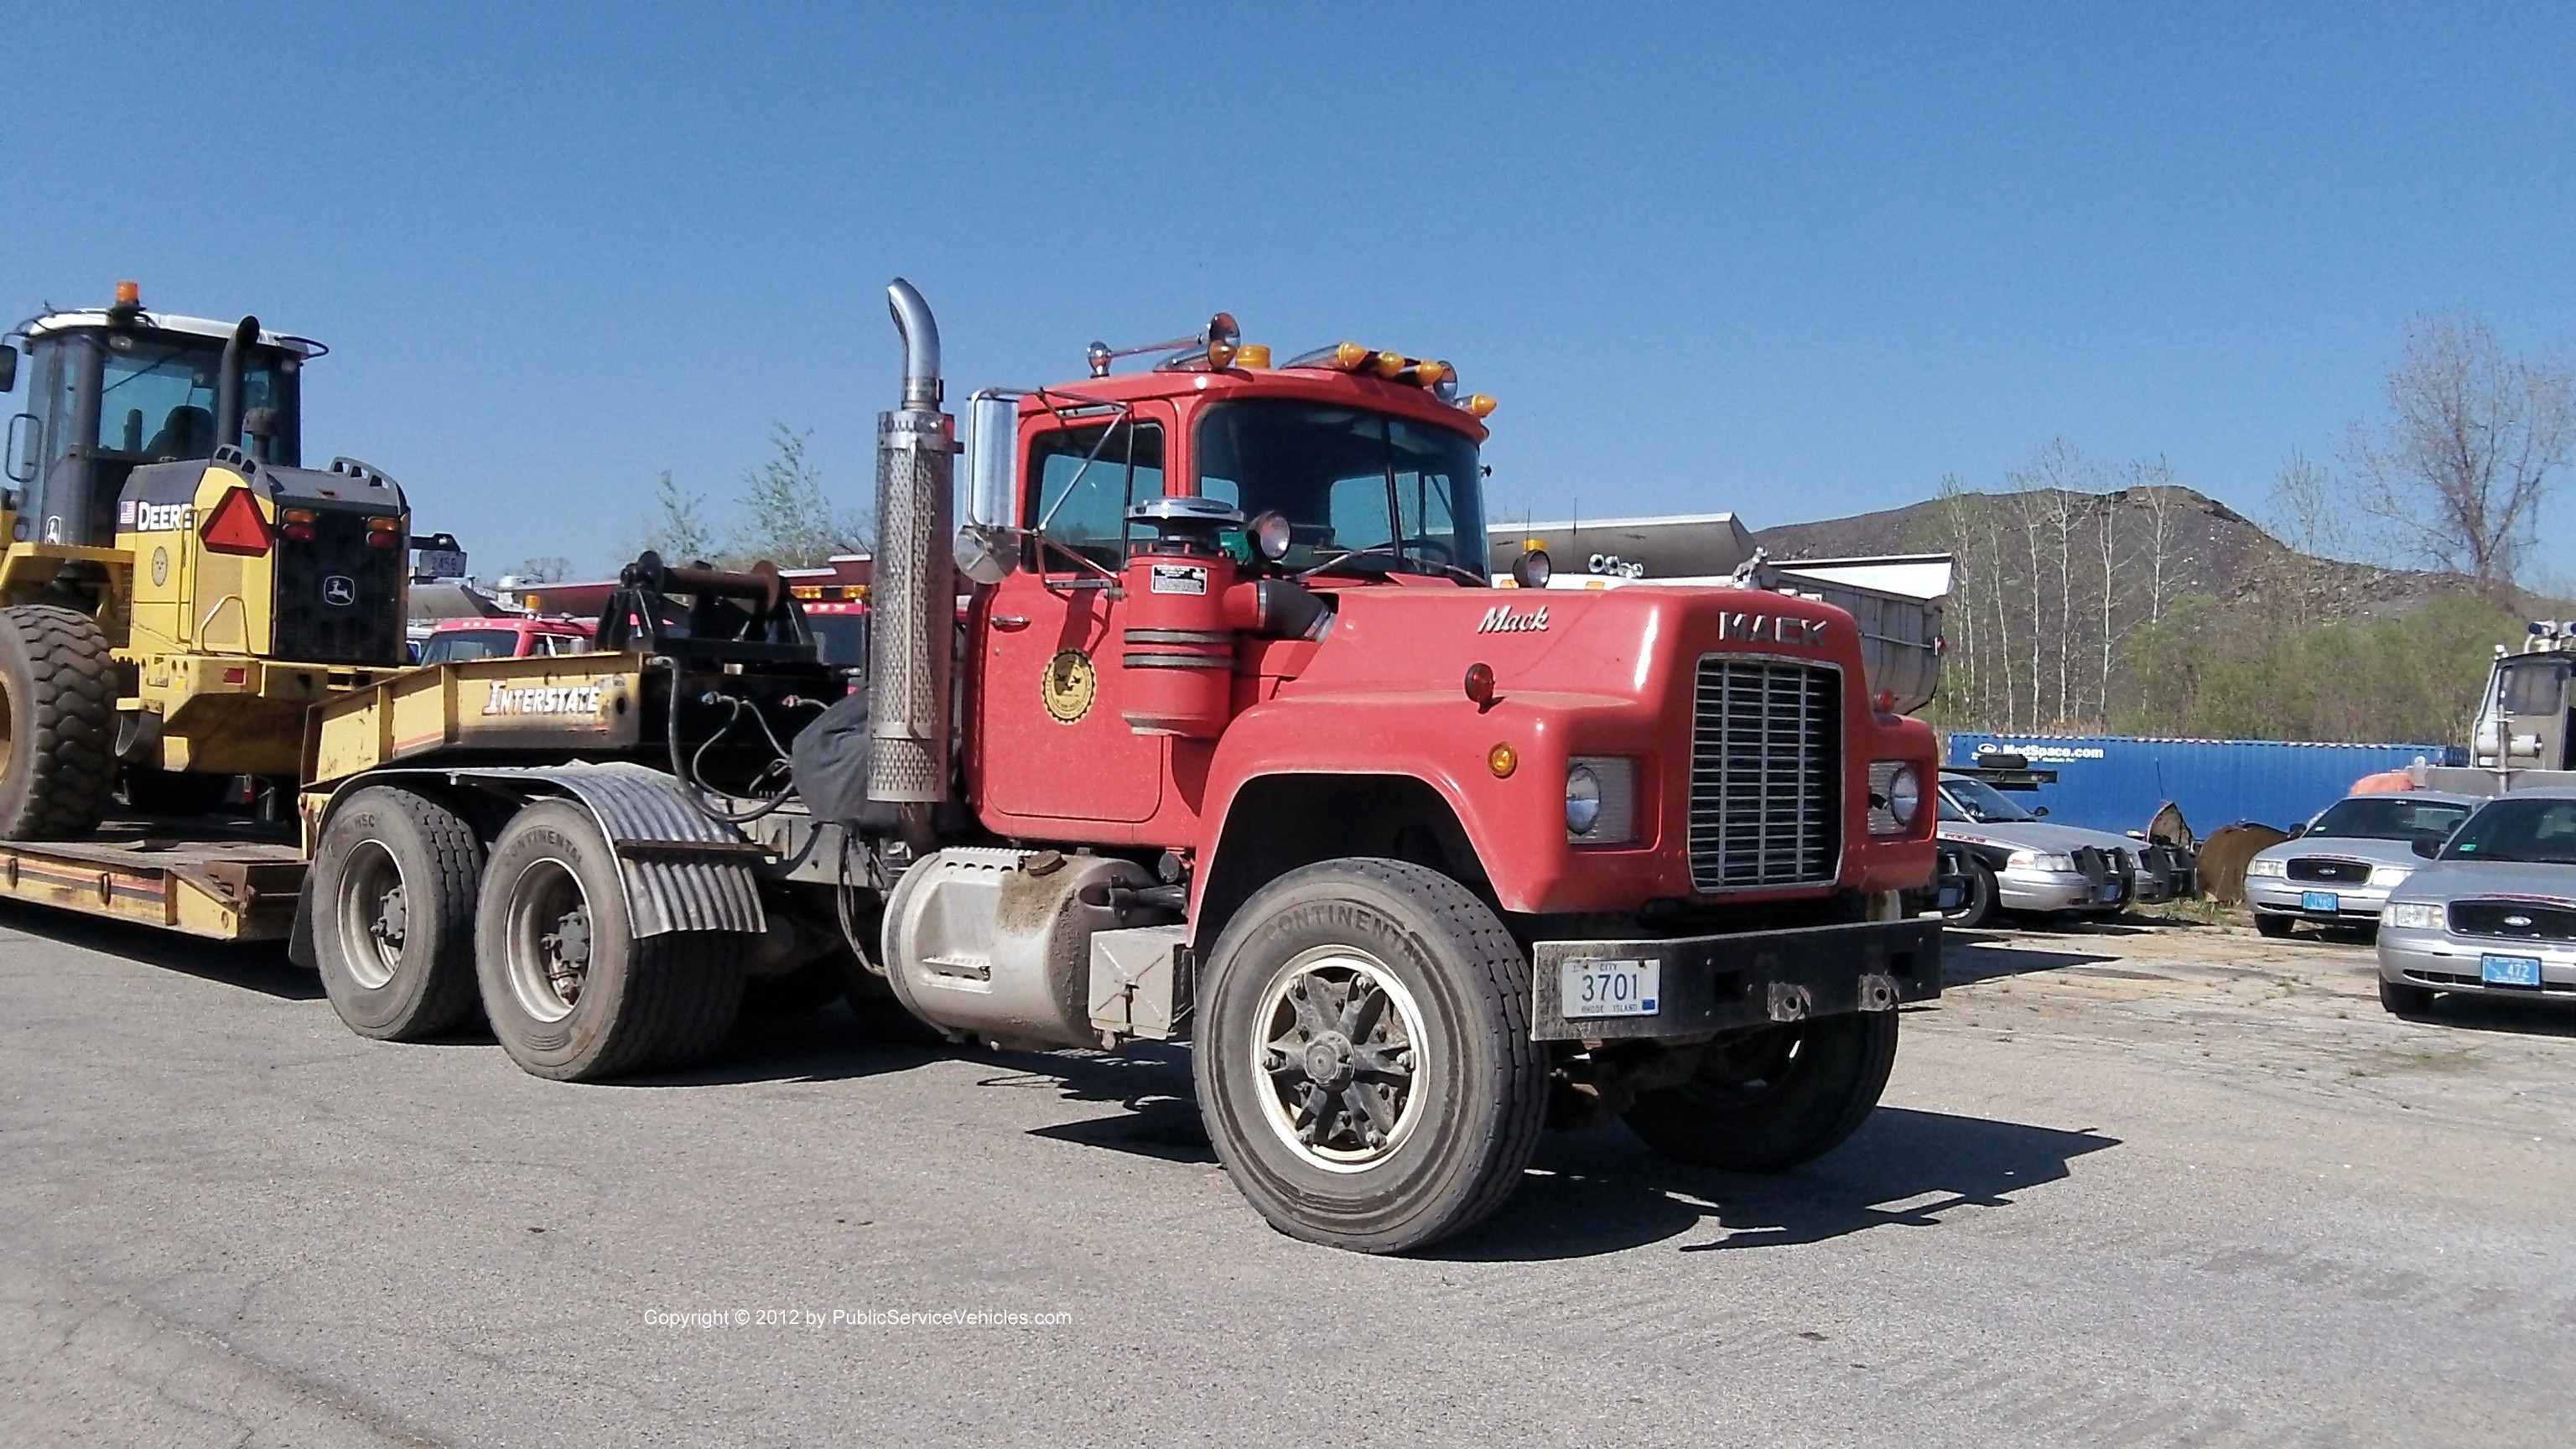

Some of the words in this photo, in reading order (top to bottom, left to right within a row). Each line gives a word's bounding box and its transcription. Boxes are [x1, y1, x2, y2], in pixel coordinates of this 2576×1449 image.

[1477, 605, 1550, 634] Mack
[1719, 610, 1827, 647] MACK
[1599, 963, 1618, 972] CITY
[2507, 963, 2530, 978] 472
[1581, 974, 1637, 1002] 3701
